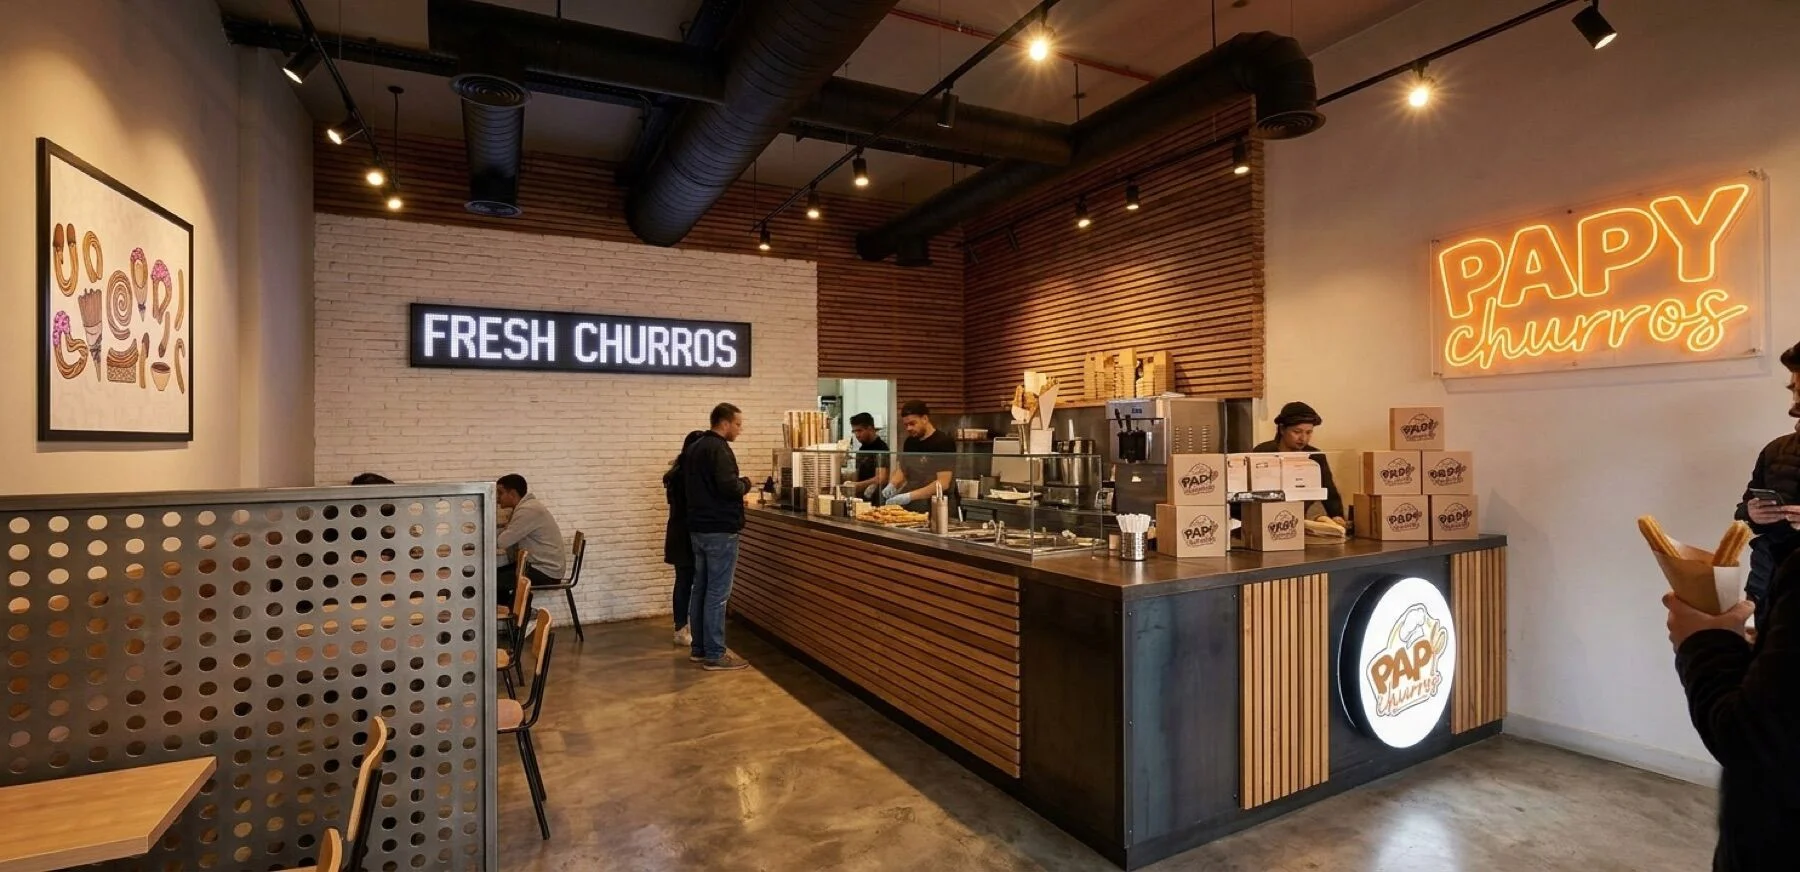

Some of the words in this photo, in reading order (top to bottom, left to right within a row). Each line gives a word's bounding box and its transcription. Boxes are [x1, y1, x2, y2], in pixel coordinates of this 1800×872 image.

[1439, 183, 1749, 319] PAPY
[423, 313, 556, 362] FRESH
[574, 322, 738, 368] CHURROS
[1445, 289, 1748, 369] churros
